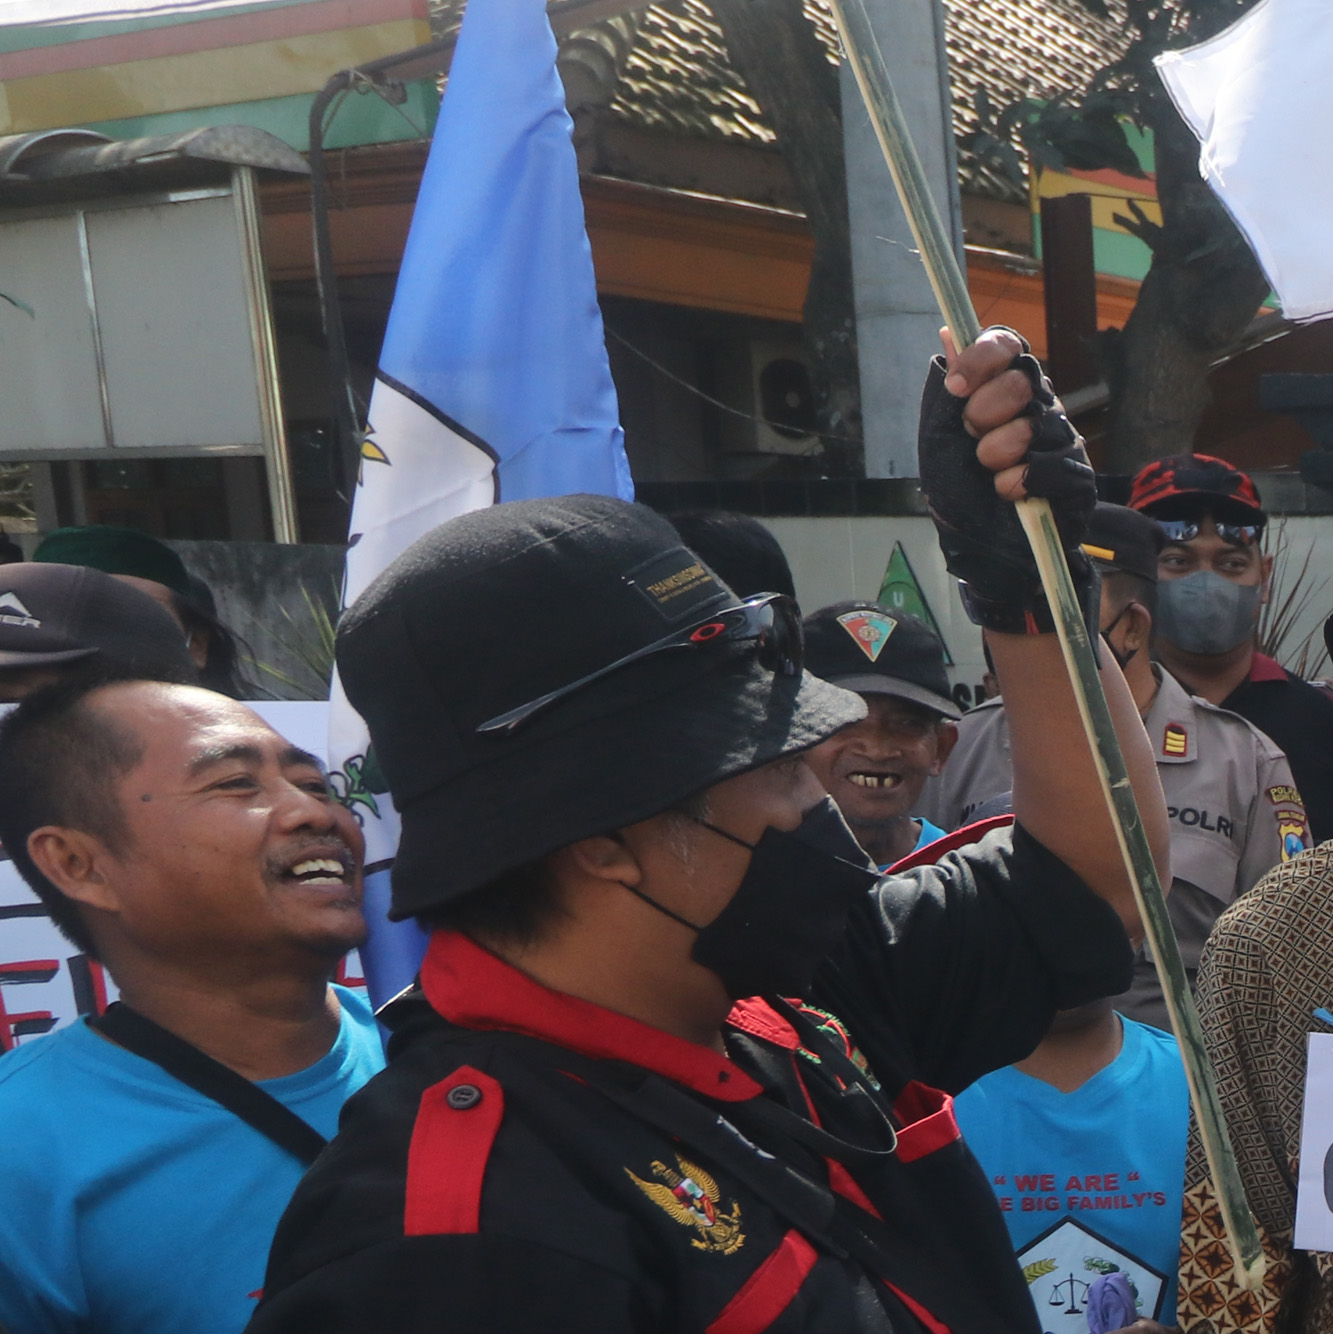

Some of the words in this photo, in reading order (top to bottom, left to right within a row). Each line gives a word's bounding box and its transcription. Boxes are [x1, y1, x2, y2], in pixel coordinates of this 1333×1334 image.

[1167, 806, 1234, 840] POLRI
[1014, 1174, 1057, 1192] WE
[1065, 1173, 1120, 1192] ARE
[1021, 1196, 1060, 1212] BIG
[1067, 1192, 1167, 1211] FAMILY'S
